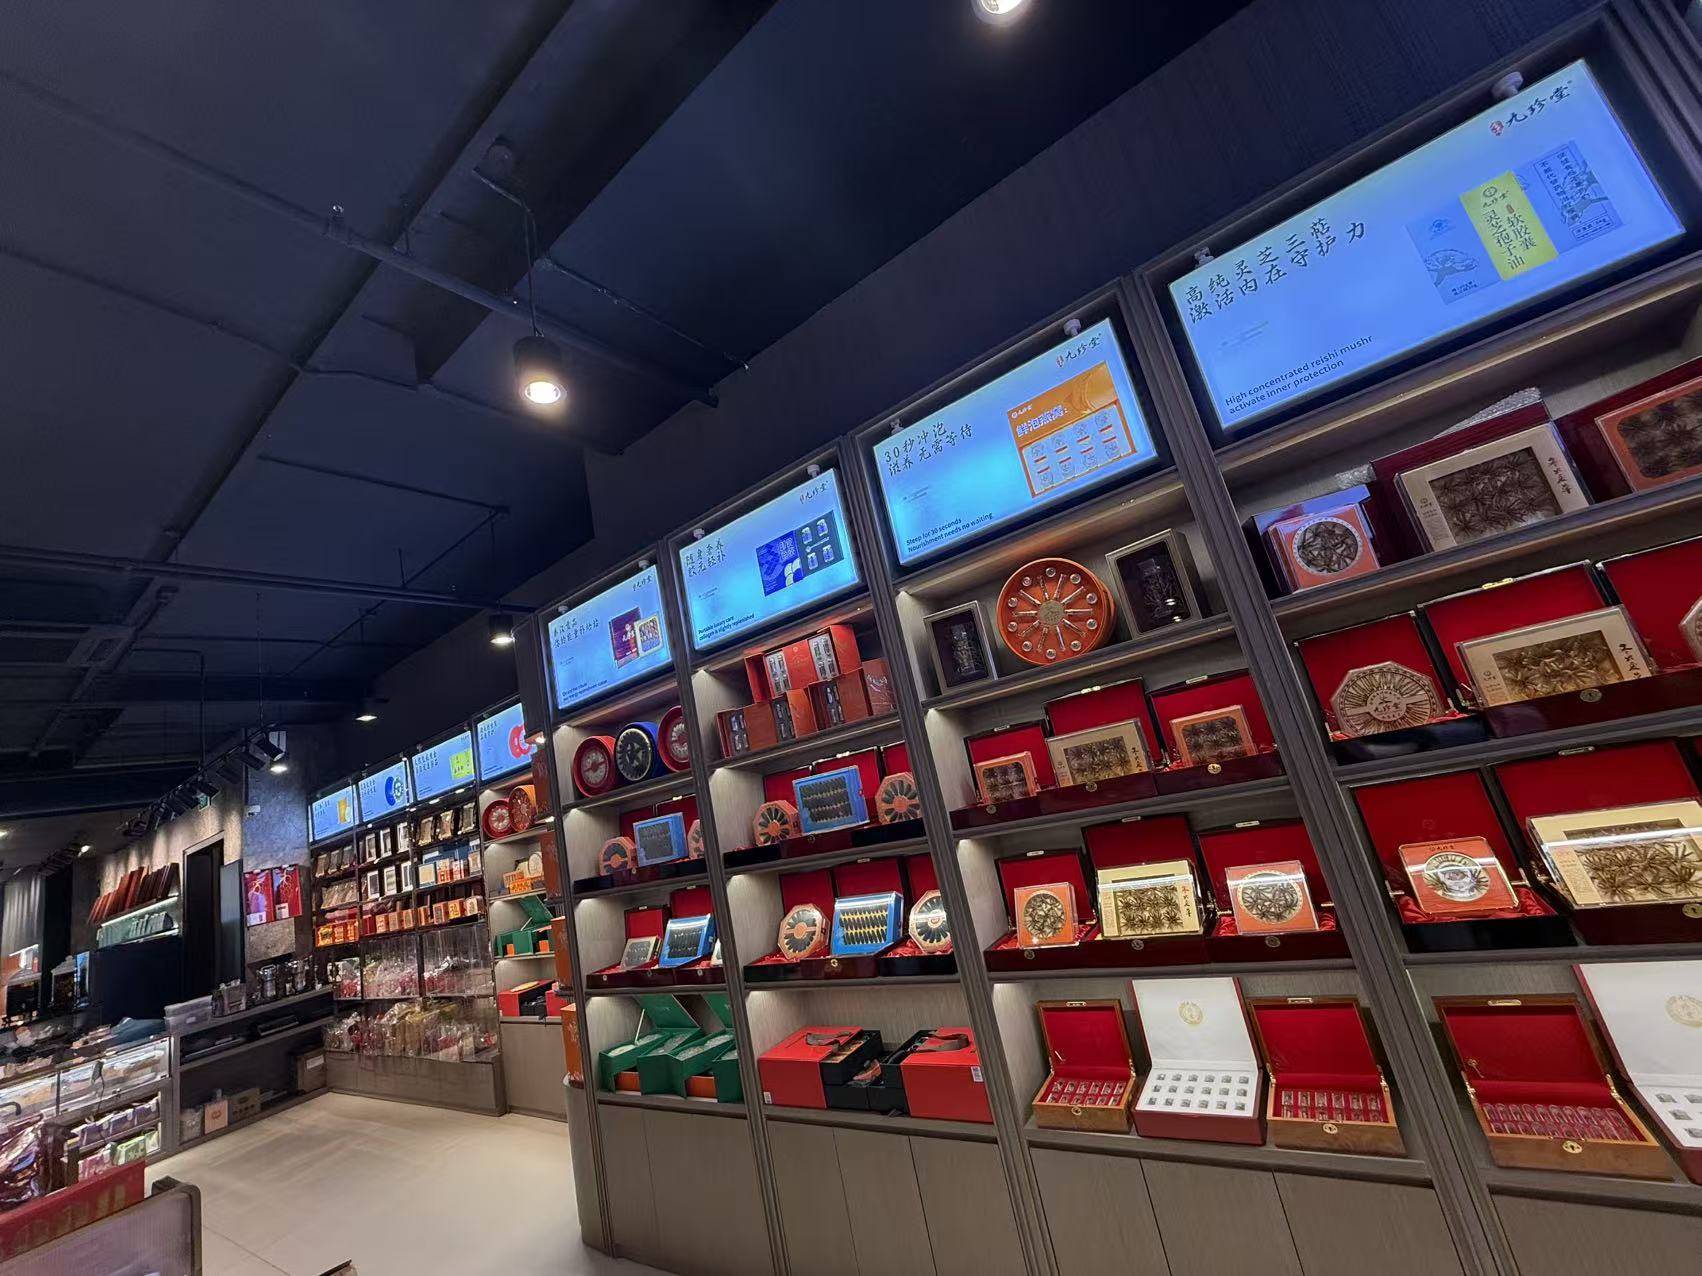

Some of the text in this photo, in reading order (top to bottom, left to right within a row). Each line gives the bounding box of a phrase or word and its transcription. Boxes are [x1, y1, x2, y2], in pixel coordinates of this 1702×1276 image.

[1503, 84, 1571, 127] 九珍堂
[1483, 209, 1525, 270] 灵芝孢子油
[1507, 212, 1537, 251] 软胶囊
[1188, 219, 1369, 323] 激活内在守护力
[1225, 335, 1374, 406] High concentrated reishi mushr
[1229, 359, 1345, 414] activate inner protection
[908, 534, 944, 553] Nourishment
[944, 526, 961, 538] needs
[939, 517, 962, 532] seconds
